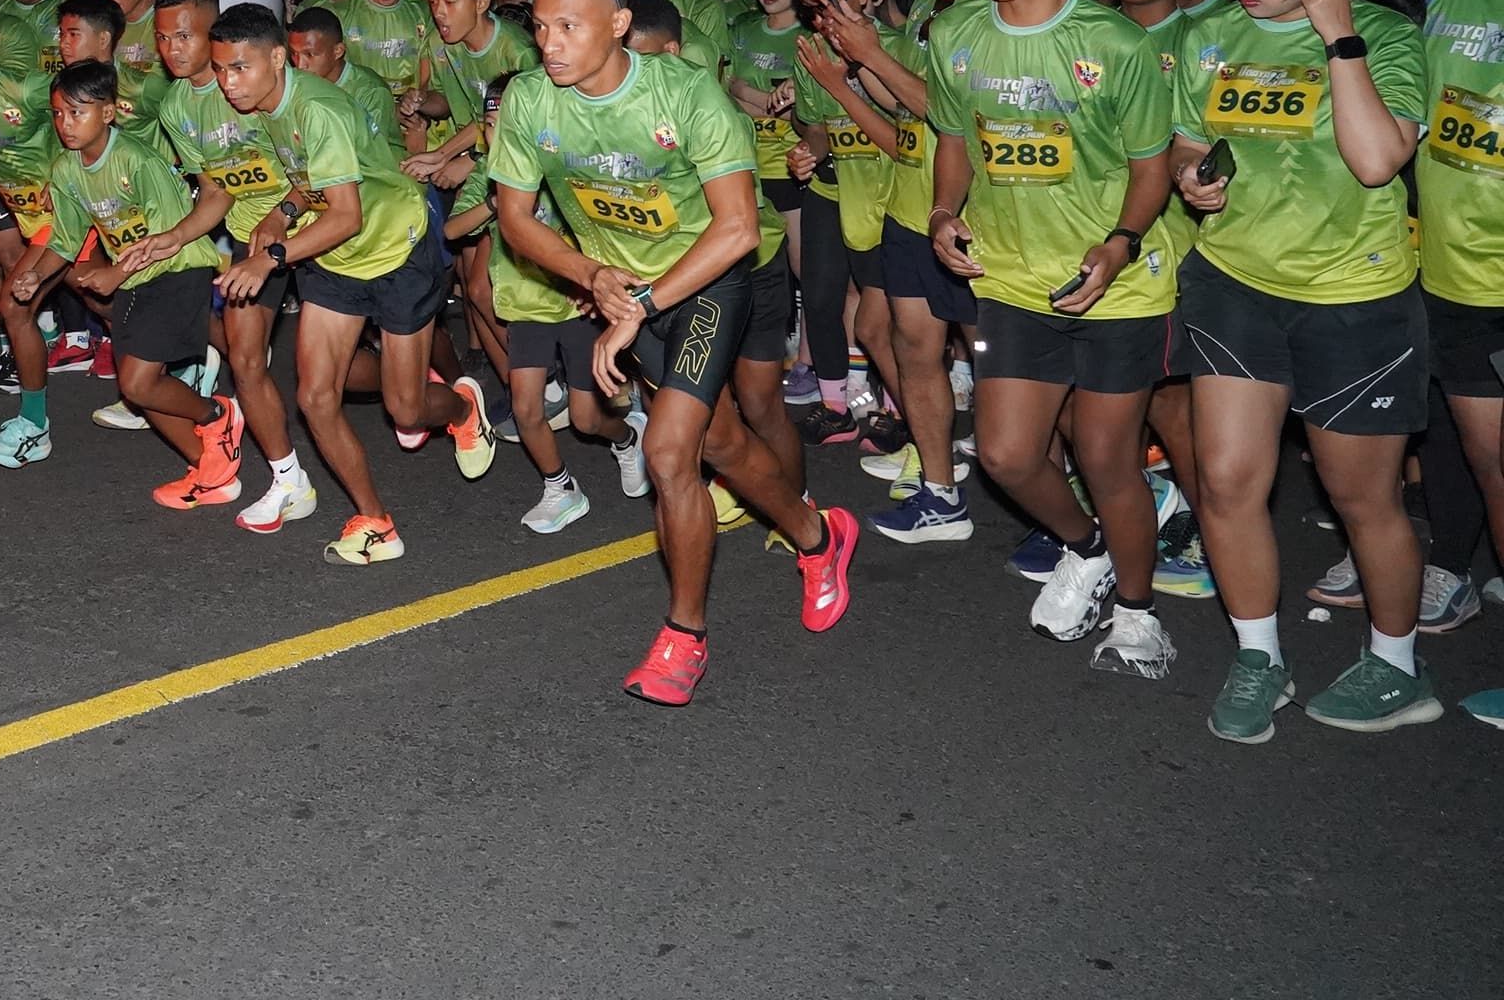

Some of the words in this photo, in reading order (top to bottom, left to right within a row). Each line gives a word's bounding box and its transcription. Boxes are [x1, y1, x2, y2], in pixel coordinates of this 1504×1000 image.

[44, 60, 65, 74] 965
[1216, 88, 1307, 116] 9636
[828, 130, 873, 148] 100
[1439, 116, 1504, 157] 984
[592, 198, 663, 227] 9391
[107, 222, 149, 249] 045
[675, 296, 720, 385] 2XU
